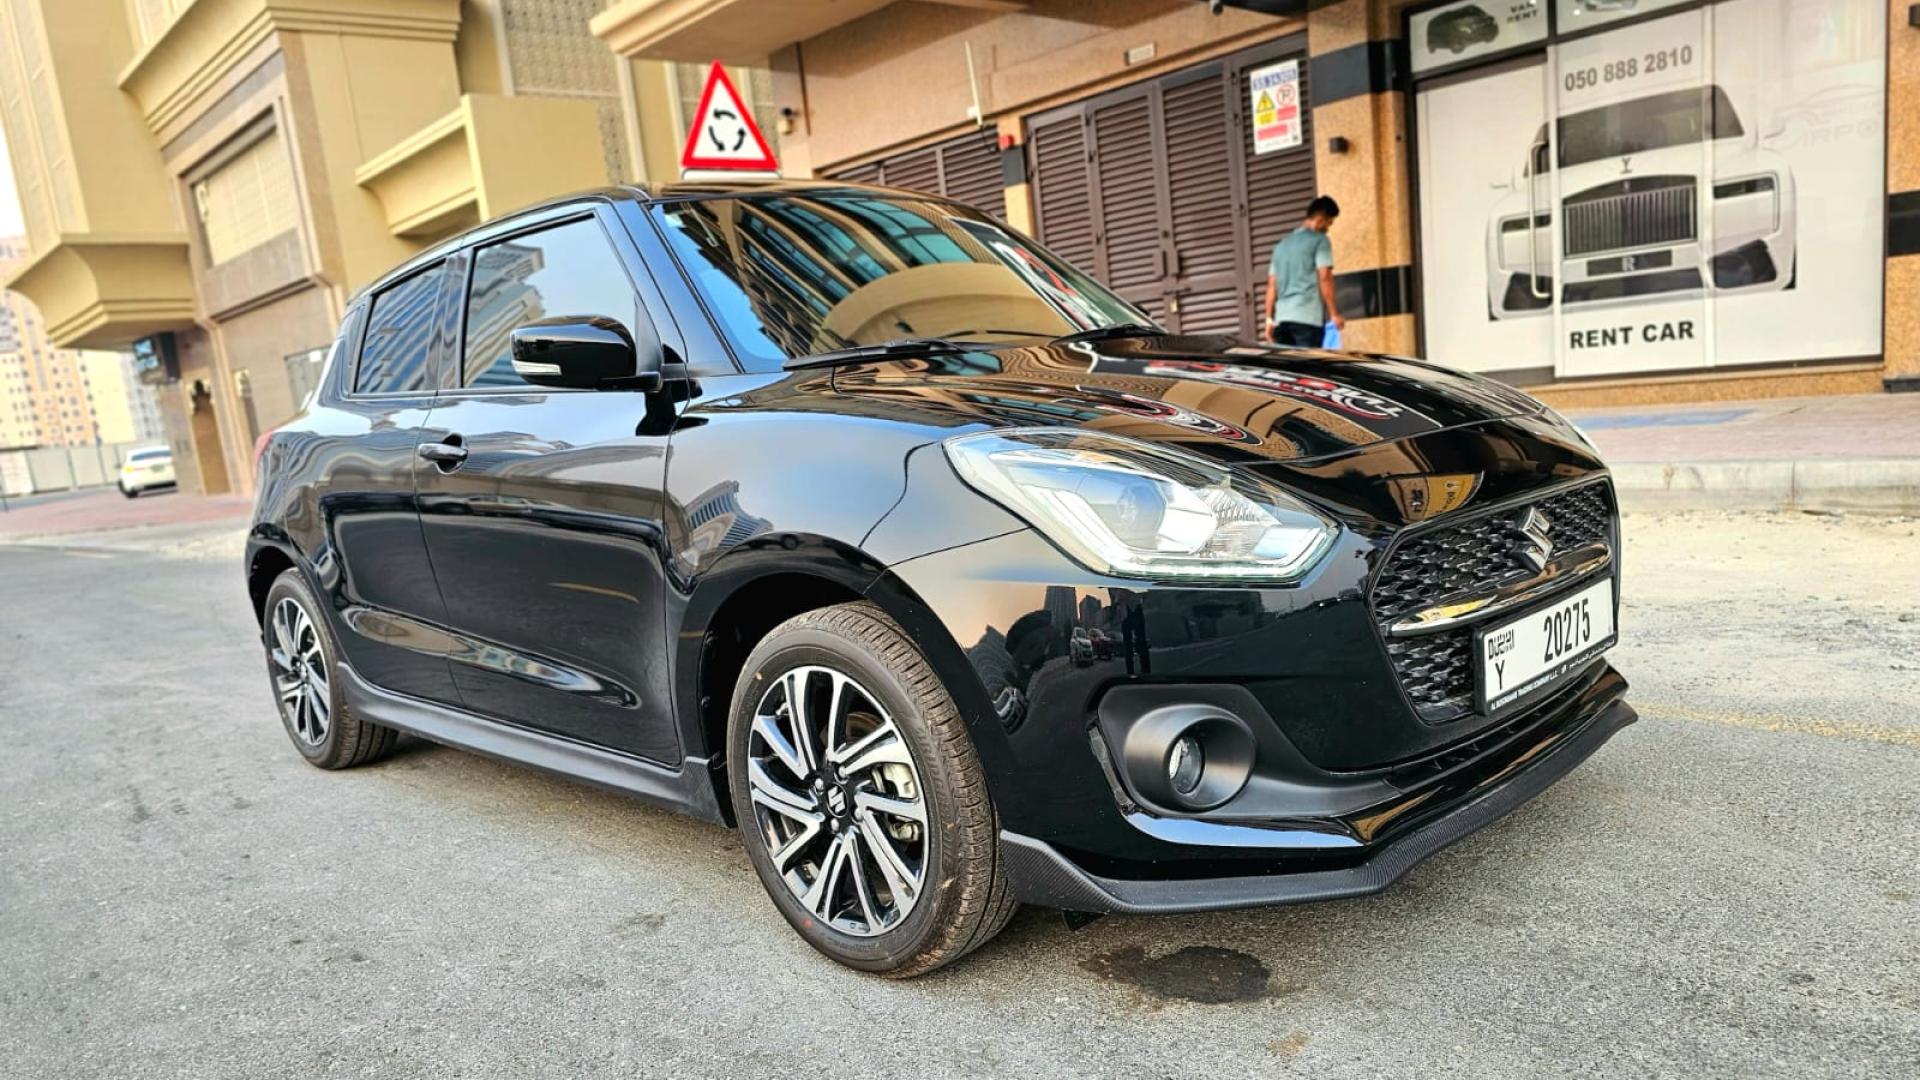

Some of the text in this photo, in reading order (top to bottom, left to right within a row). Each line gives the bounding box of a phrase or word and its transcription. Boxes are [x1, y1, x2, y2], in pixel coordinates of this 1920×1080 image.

[1565, 45, 1693, 92] 050 888 2810
[1570, 320, 1694, 349] RENT CAR
[1543, 598, 1591, 664] 20275
[1495, 659, 1505, 690] Y
